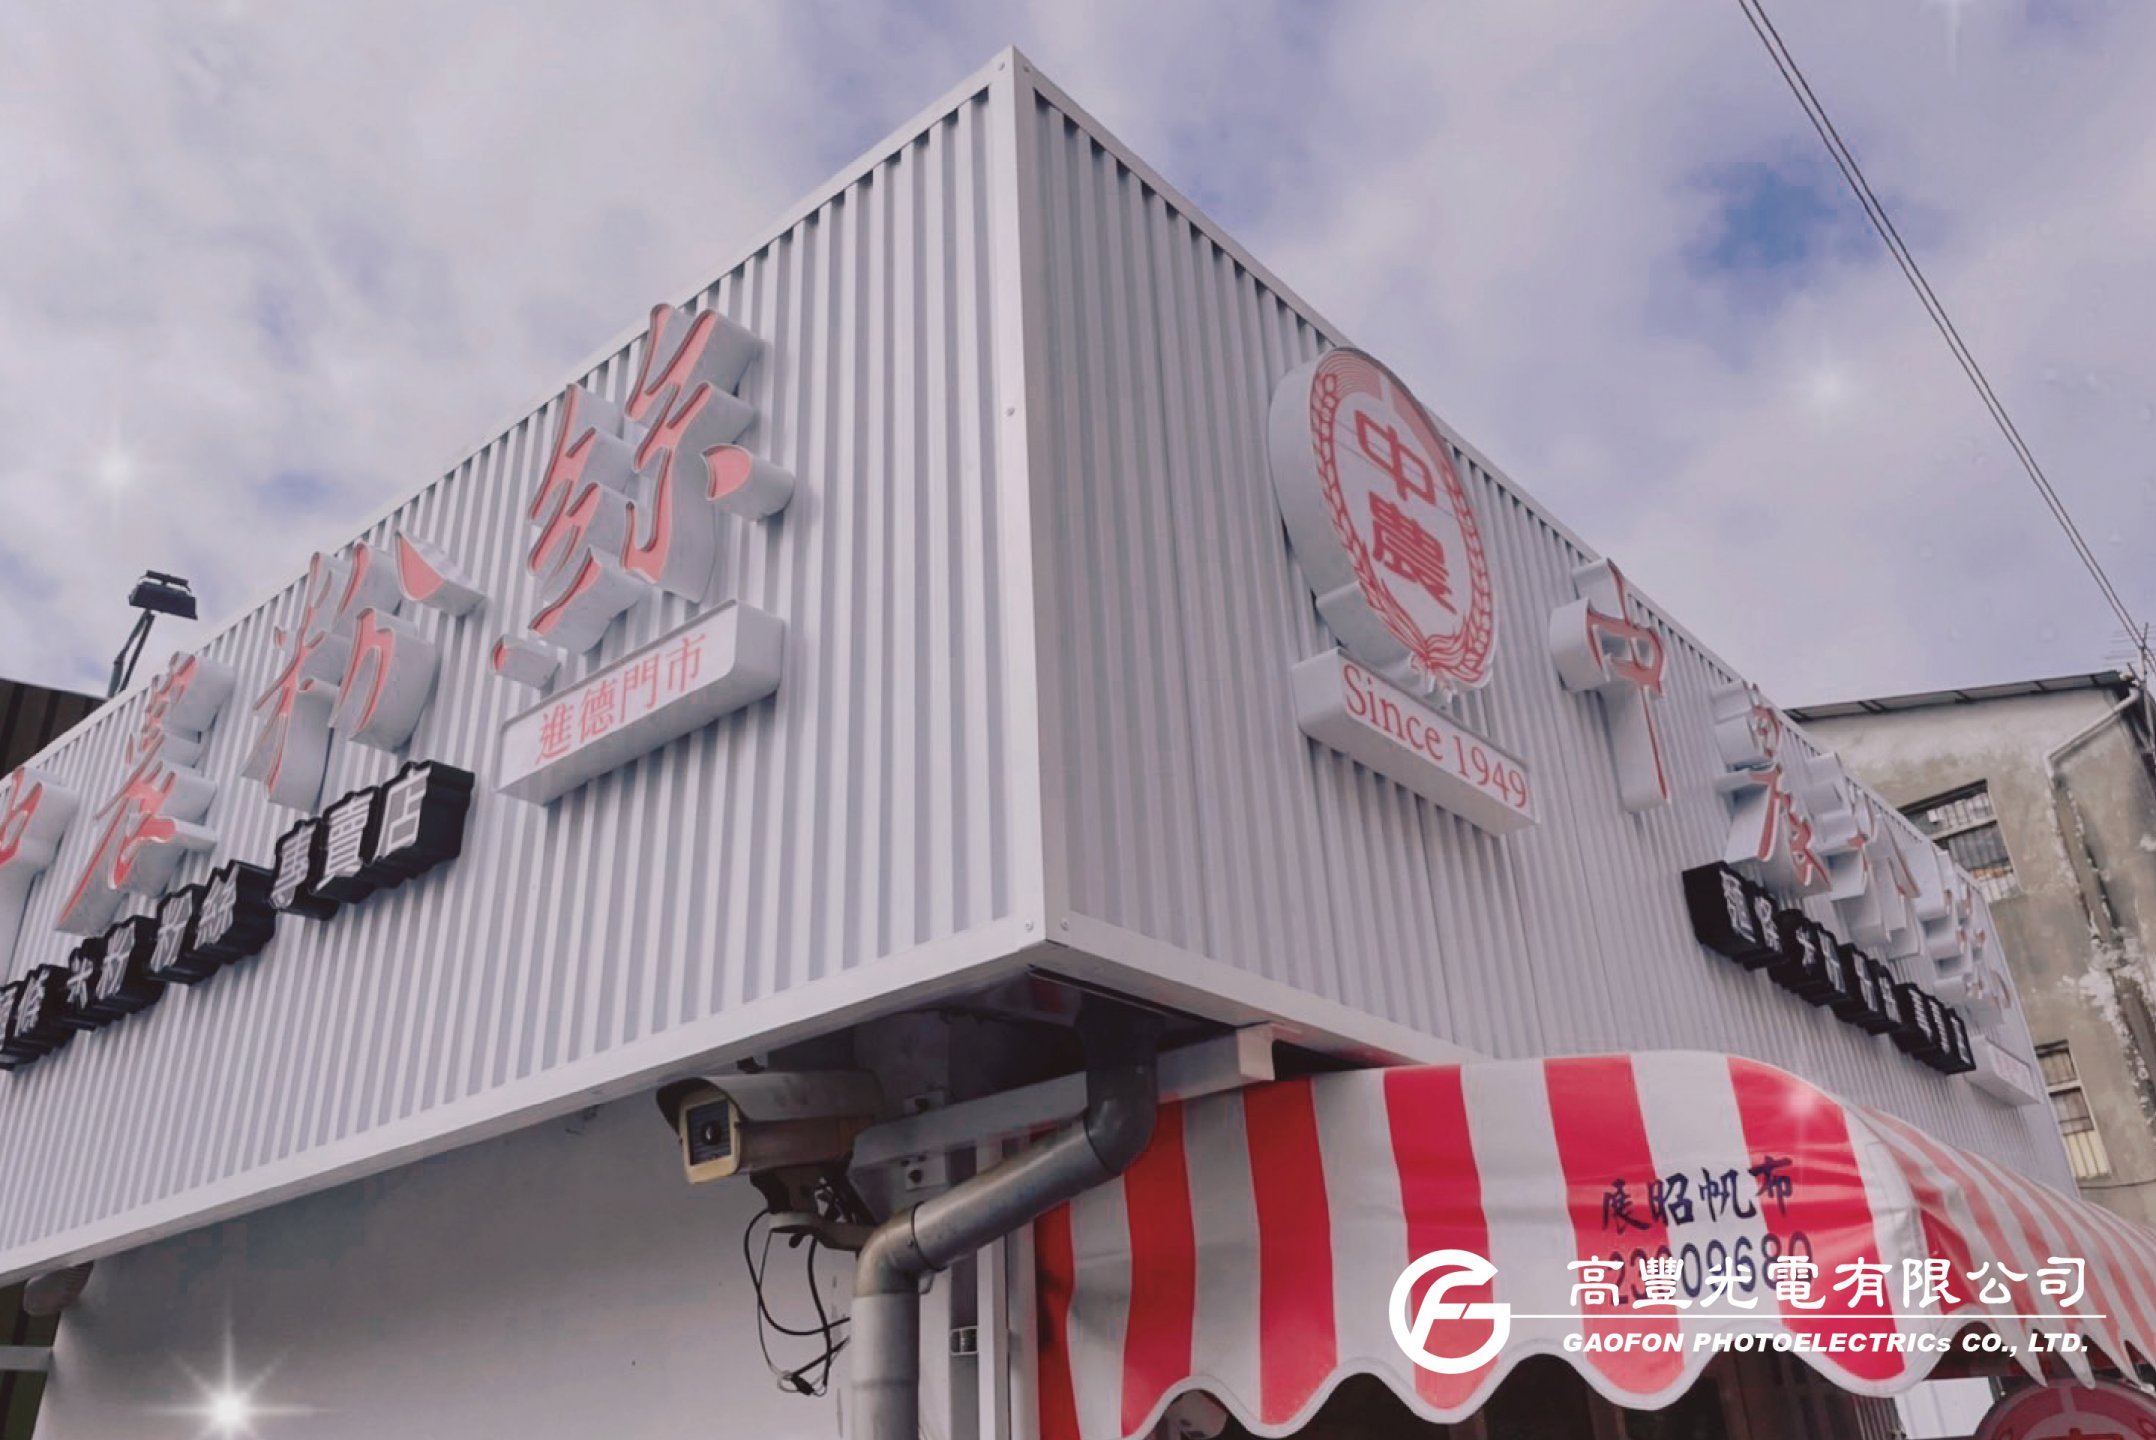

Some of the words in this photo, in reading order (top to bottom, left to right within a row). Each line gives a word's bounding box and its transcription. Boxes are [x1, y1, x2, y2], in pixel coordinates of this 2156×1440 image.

[536, 633, 706, 766] 進德門市
[1343, 663, 1443, 761] Since
[1453, 734, 1527, 808] 1949
[1602, 1155, 1793, 1235] 展昭帆布
